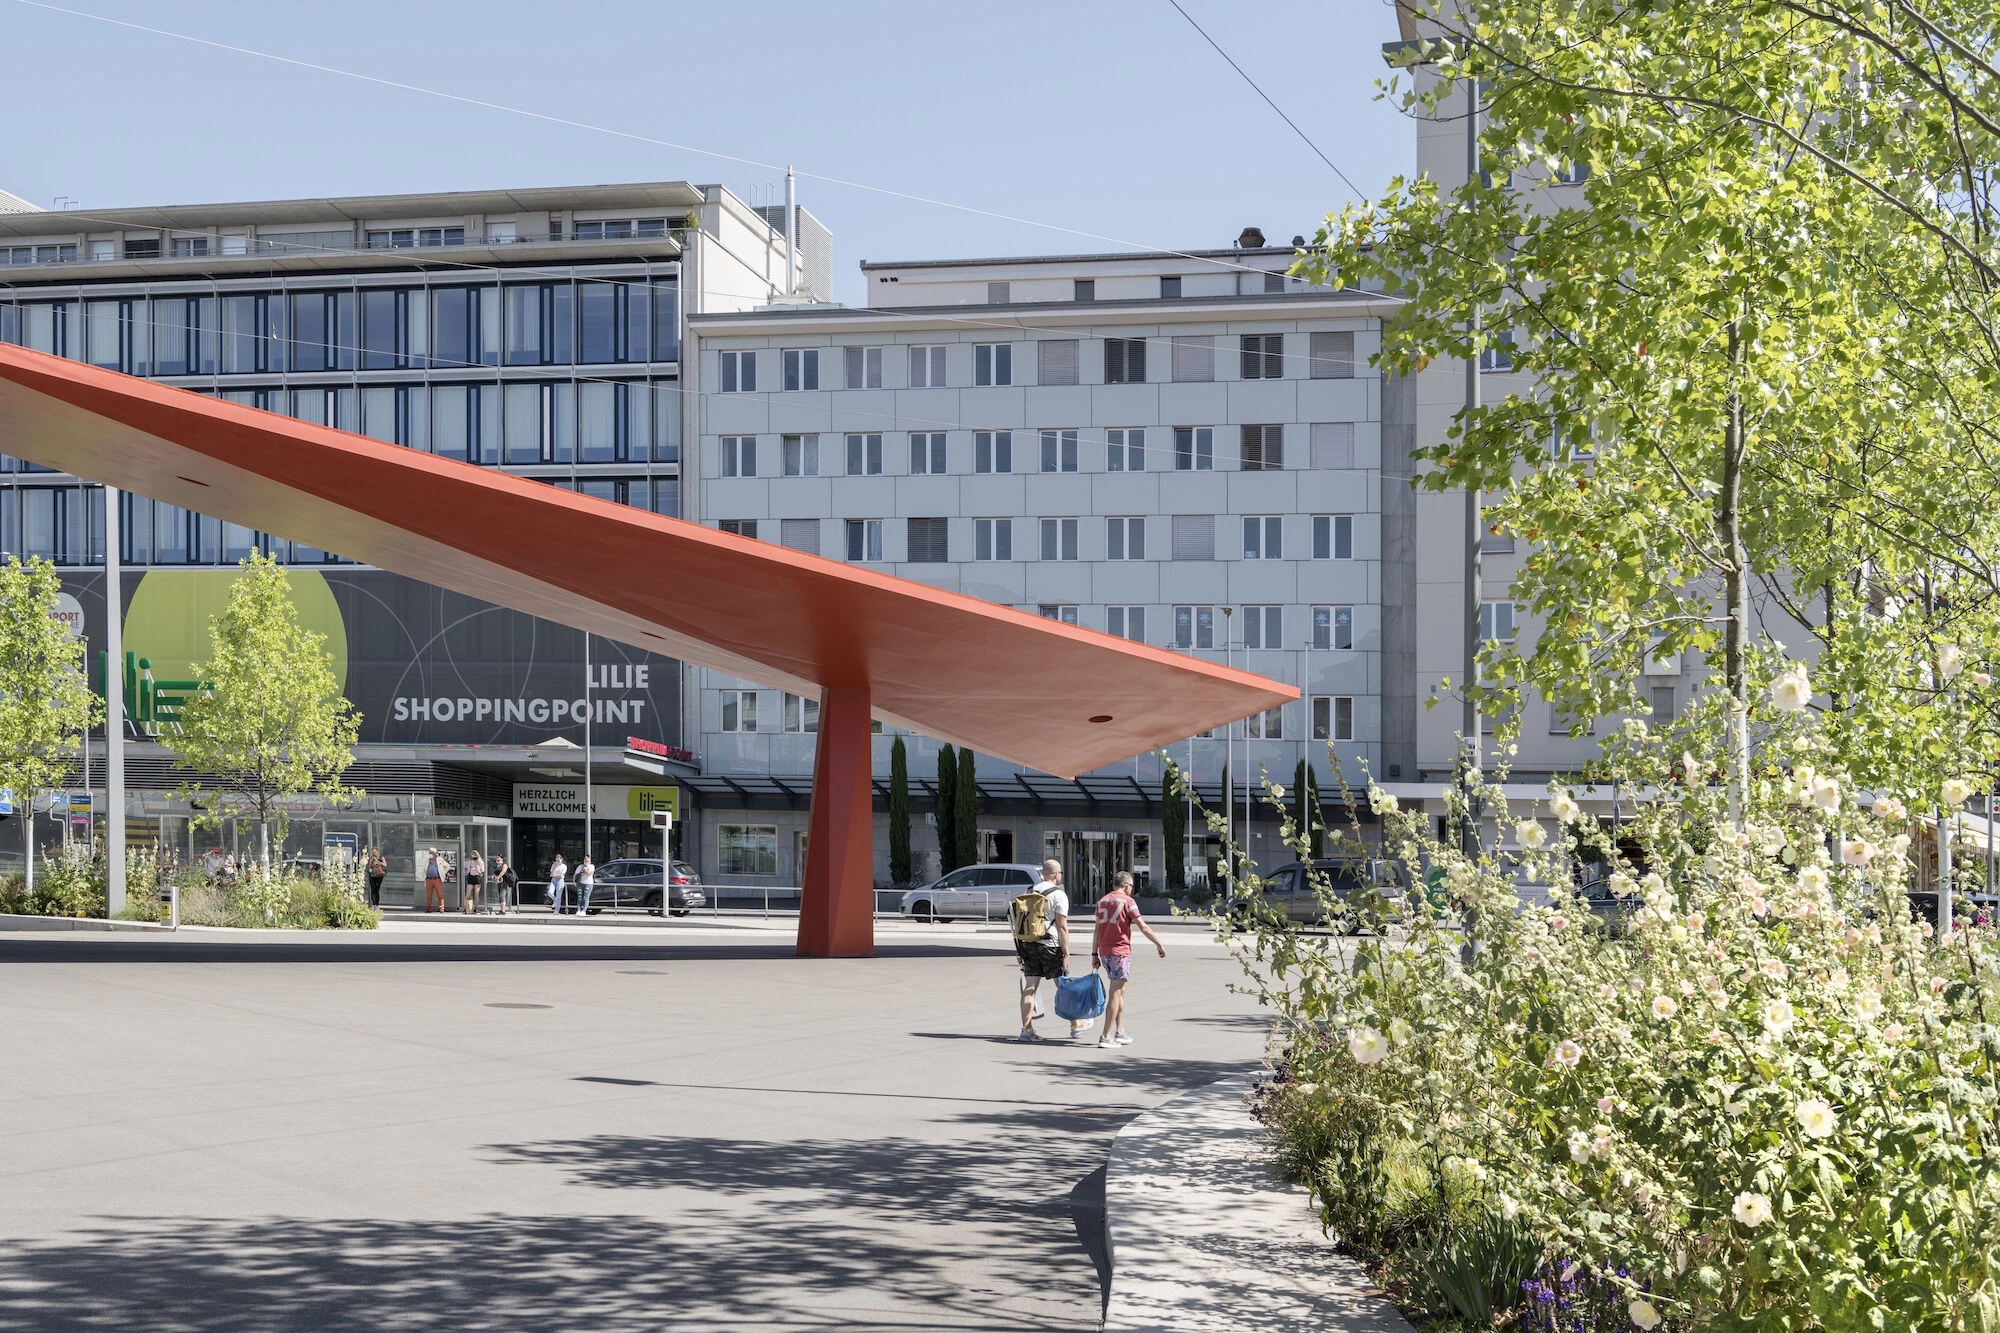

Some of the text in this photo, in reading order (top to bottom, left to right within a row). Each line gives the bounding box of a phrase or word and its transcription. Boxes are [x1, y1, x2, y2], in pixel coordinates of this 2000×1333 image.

[588, 664, 649, 688] LILIE
[393, 697, 646, 724] SHOPPINGPOINT
[519, 789, 576, 800] HERZLICH
[519, 802, 597, 813] WILLKOMMEN
[1098, 898, 1126, 924] 57
